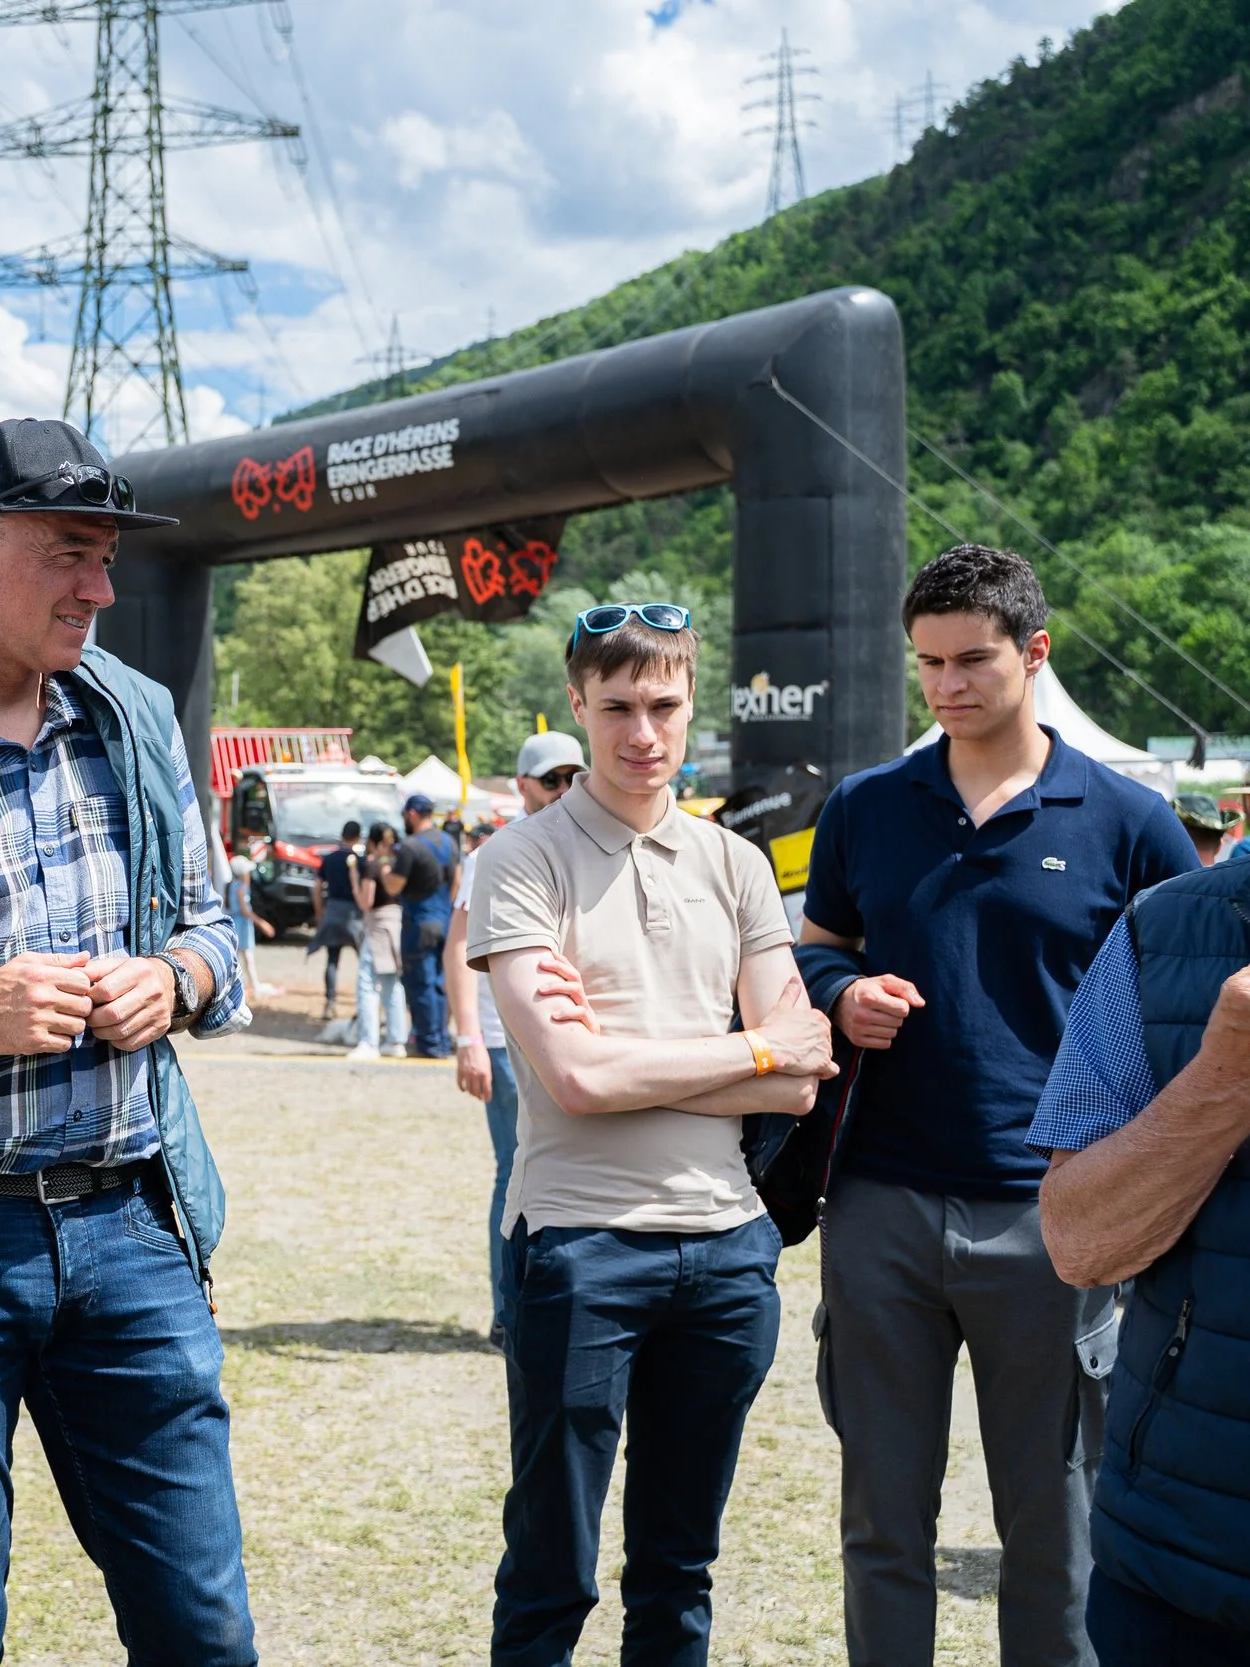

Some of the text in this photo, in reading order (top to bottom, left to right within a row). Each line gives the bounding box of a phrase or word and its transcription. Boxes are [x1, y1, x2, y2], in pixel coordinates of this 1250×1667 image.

[327, 418, 460, 465] RACE D'HÉRENS
[327, 443, 454, 489] ERINGERRASSE
[330, 483, 377, 504] TOUR
[731, 680, 829, 722] exner
